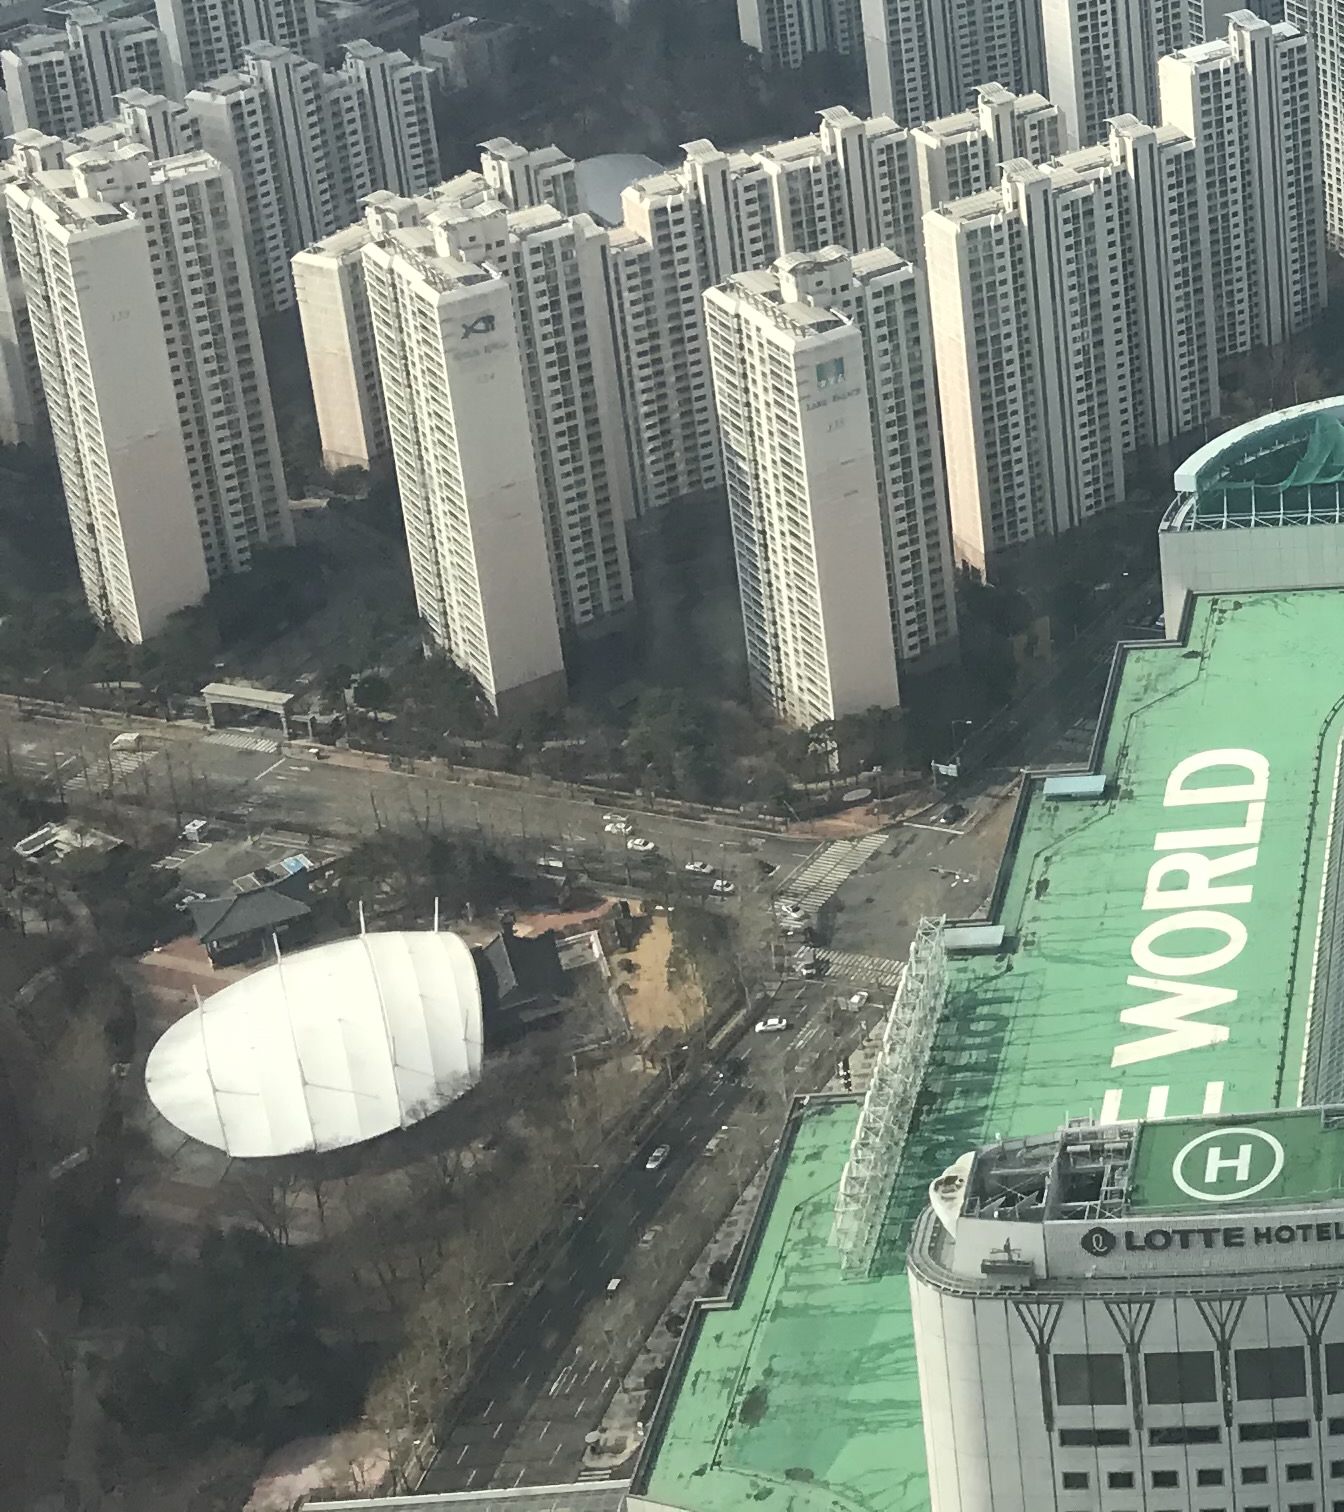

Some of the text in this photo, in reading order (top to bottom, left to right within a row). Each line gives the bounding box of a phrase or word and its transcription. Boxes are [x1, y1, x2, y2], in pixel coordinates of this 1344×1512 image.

[1110, 748, 1270, 1068] WORLD
[1204, 1144, 1252, 1183] H
[1124, 1226, 1245, 1251] LOTTE
